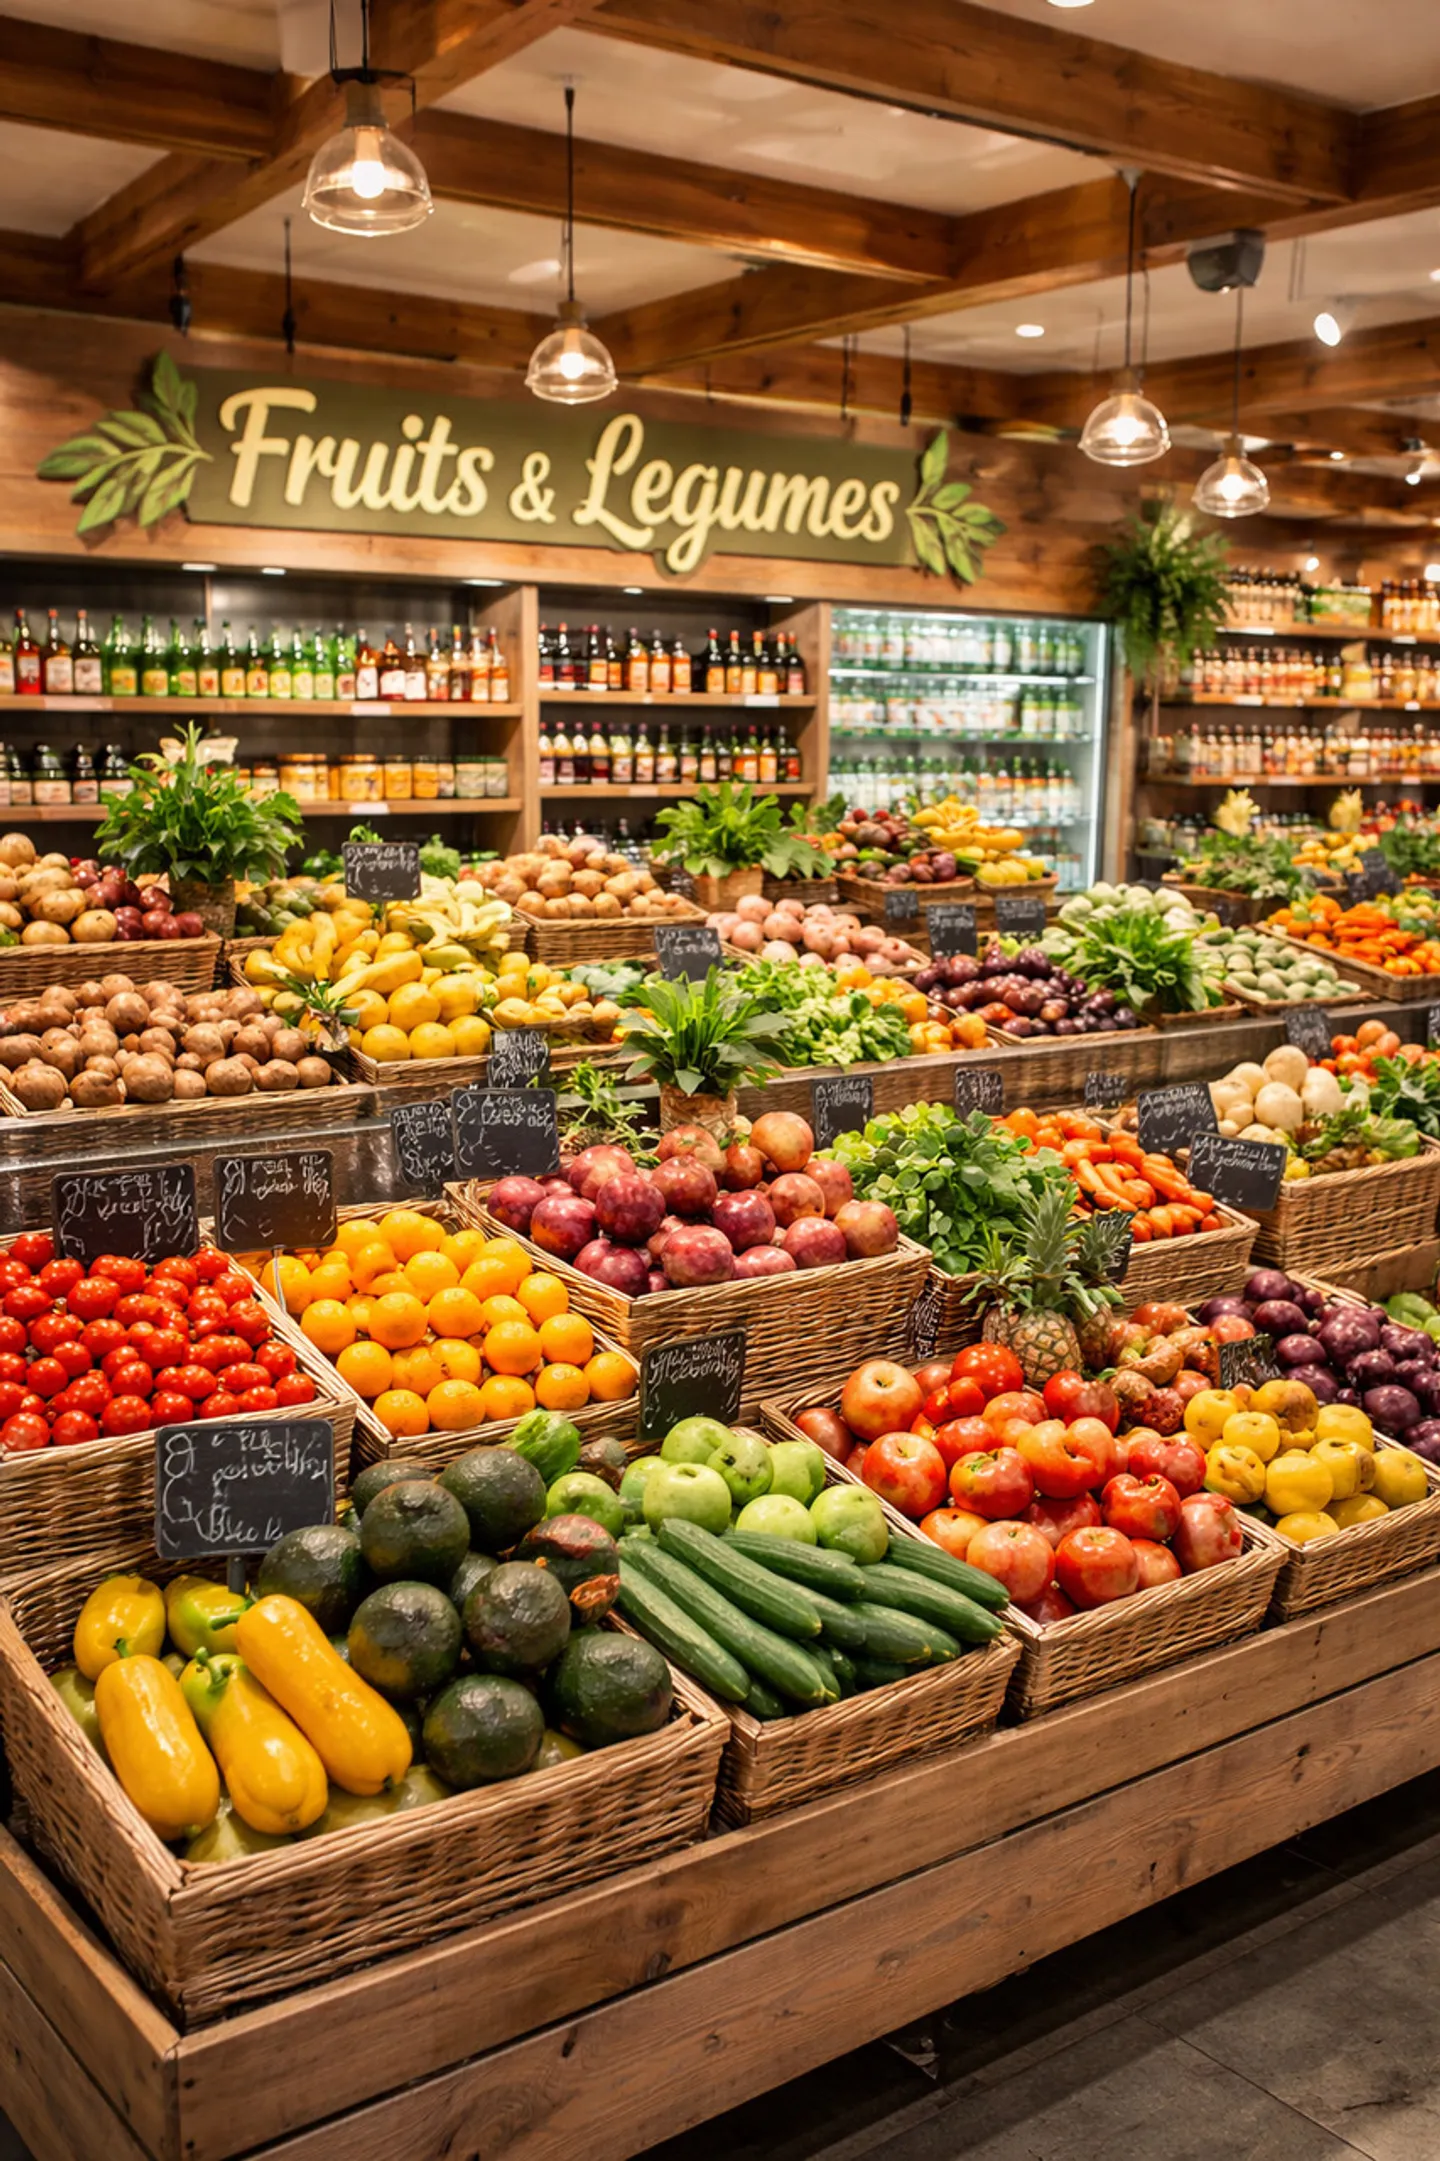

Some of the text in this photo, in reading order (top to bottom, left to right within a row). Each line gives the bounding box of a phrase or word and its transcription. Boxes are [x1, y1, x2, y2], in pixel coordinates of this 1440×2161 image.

[220, 387, 900, 573] Fruits & Legumes
